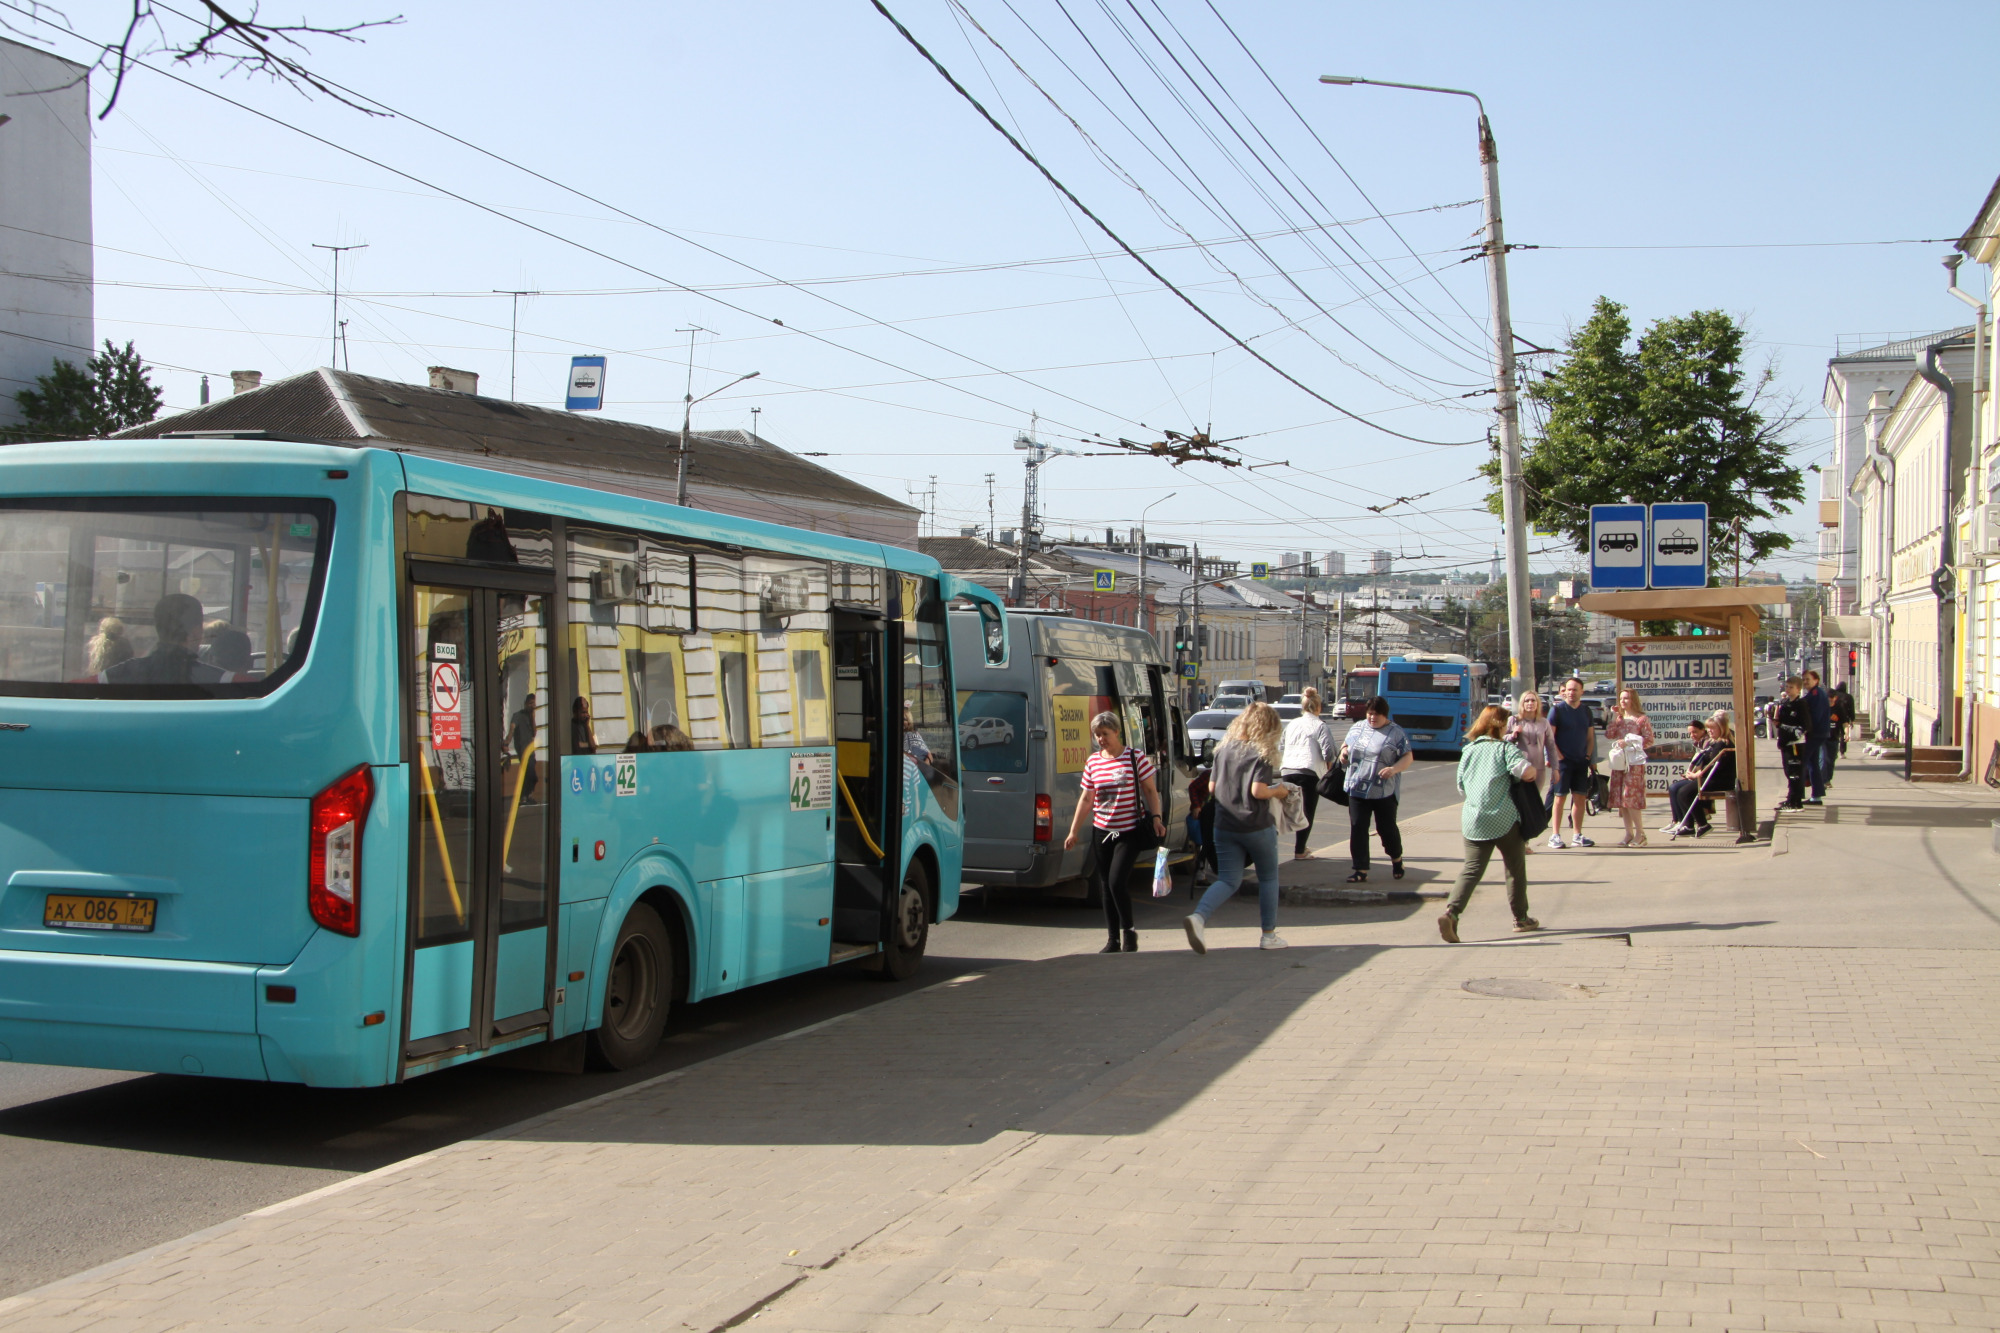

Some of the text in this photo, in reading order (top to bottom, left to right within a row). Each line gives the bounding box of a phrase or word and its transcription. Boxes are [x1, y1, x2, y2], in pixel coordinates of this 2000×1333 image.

[436, 646, 456, 656] ВХОД
[1689, 701, 1734, 711] ПЕРСОНА
[1058, 704, 1084, 722] Закажи
[1061, 728, 1080, 741] такси
[618, 764, 635, 788] 42
[1645, 765, 1669, 777] 872)
[790, 776, 810, 808] 42
[1645, 780, 1669, 791] 872)
[53, 900, 148, 921] АХ 086 71
